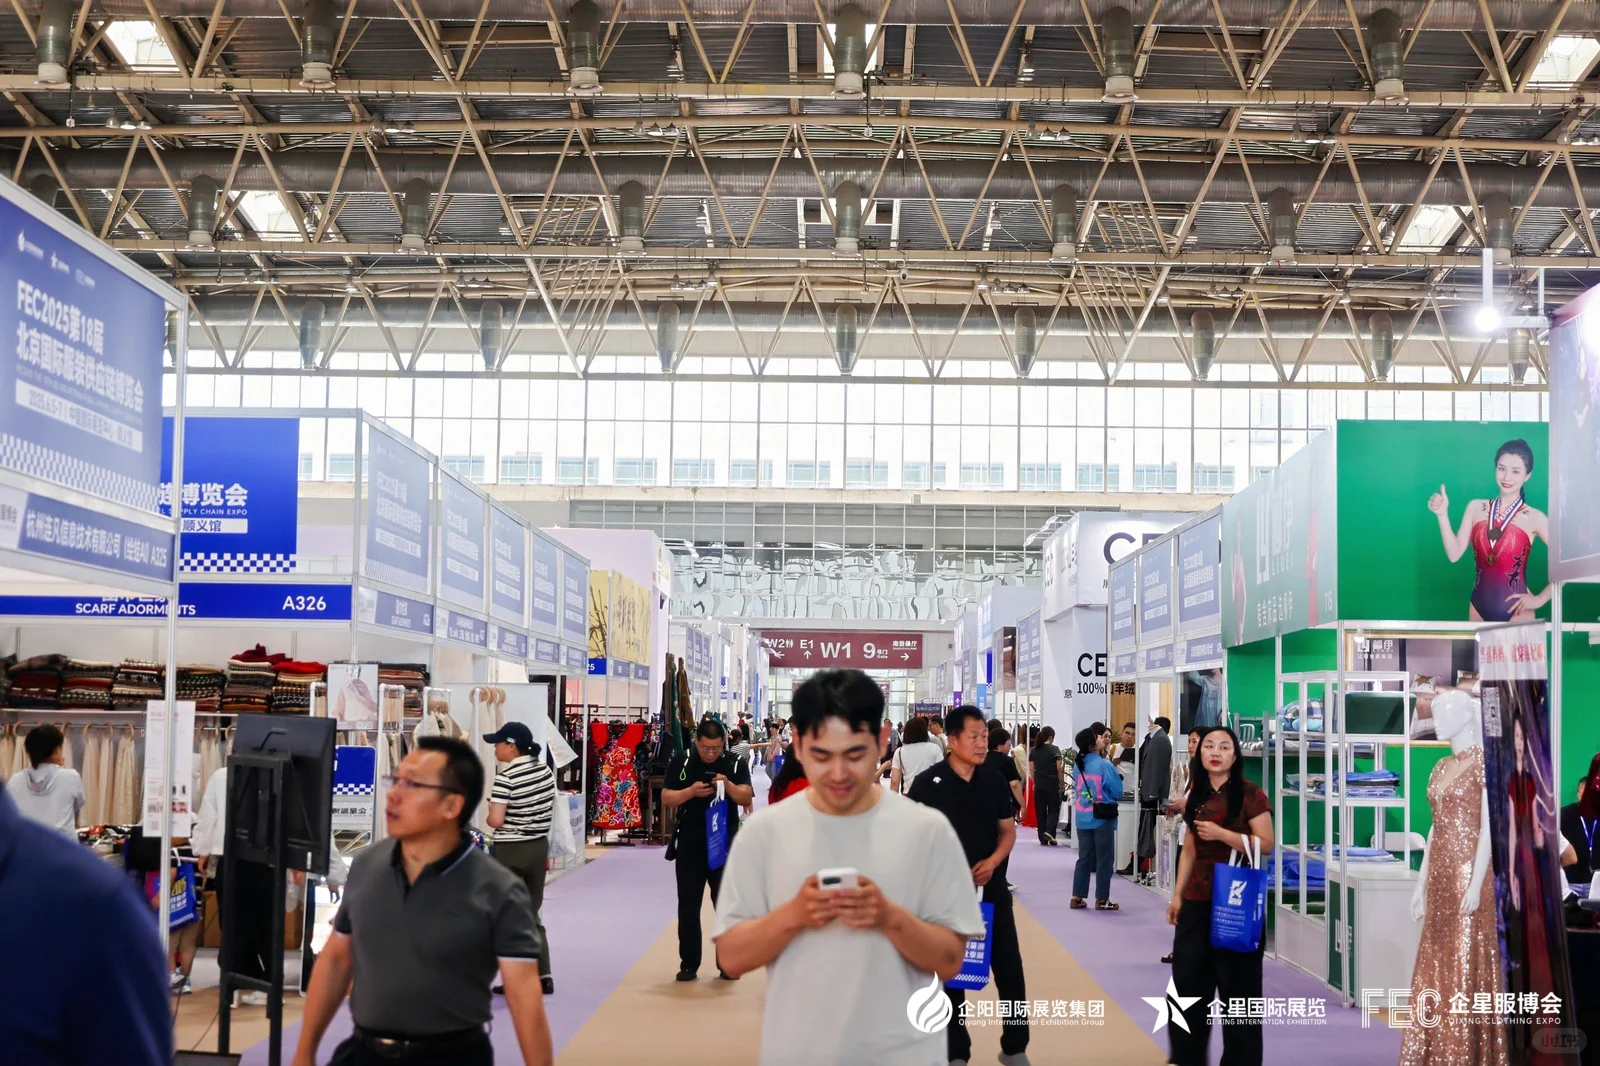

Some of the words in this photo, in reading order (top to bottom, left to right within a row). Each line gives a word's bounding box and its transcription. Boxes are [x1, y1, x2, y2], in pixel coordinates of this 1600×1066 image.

[17, 279, 104, 355] FEC2025第18届
[226, 508, 248, 516] EXPO
[183, 519, 222, 532] 顺义馆
[75, 603, 116, 613] SCARF
[283, 596, 327, 611] A326
[800, 640, 814, 649] E1
[820, 642, 851, 659] W1
[863, 642, 876, 659] 9
